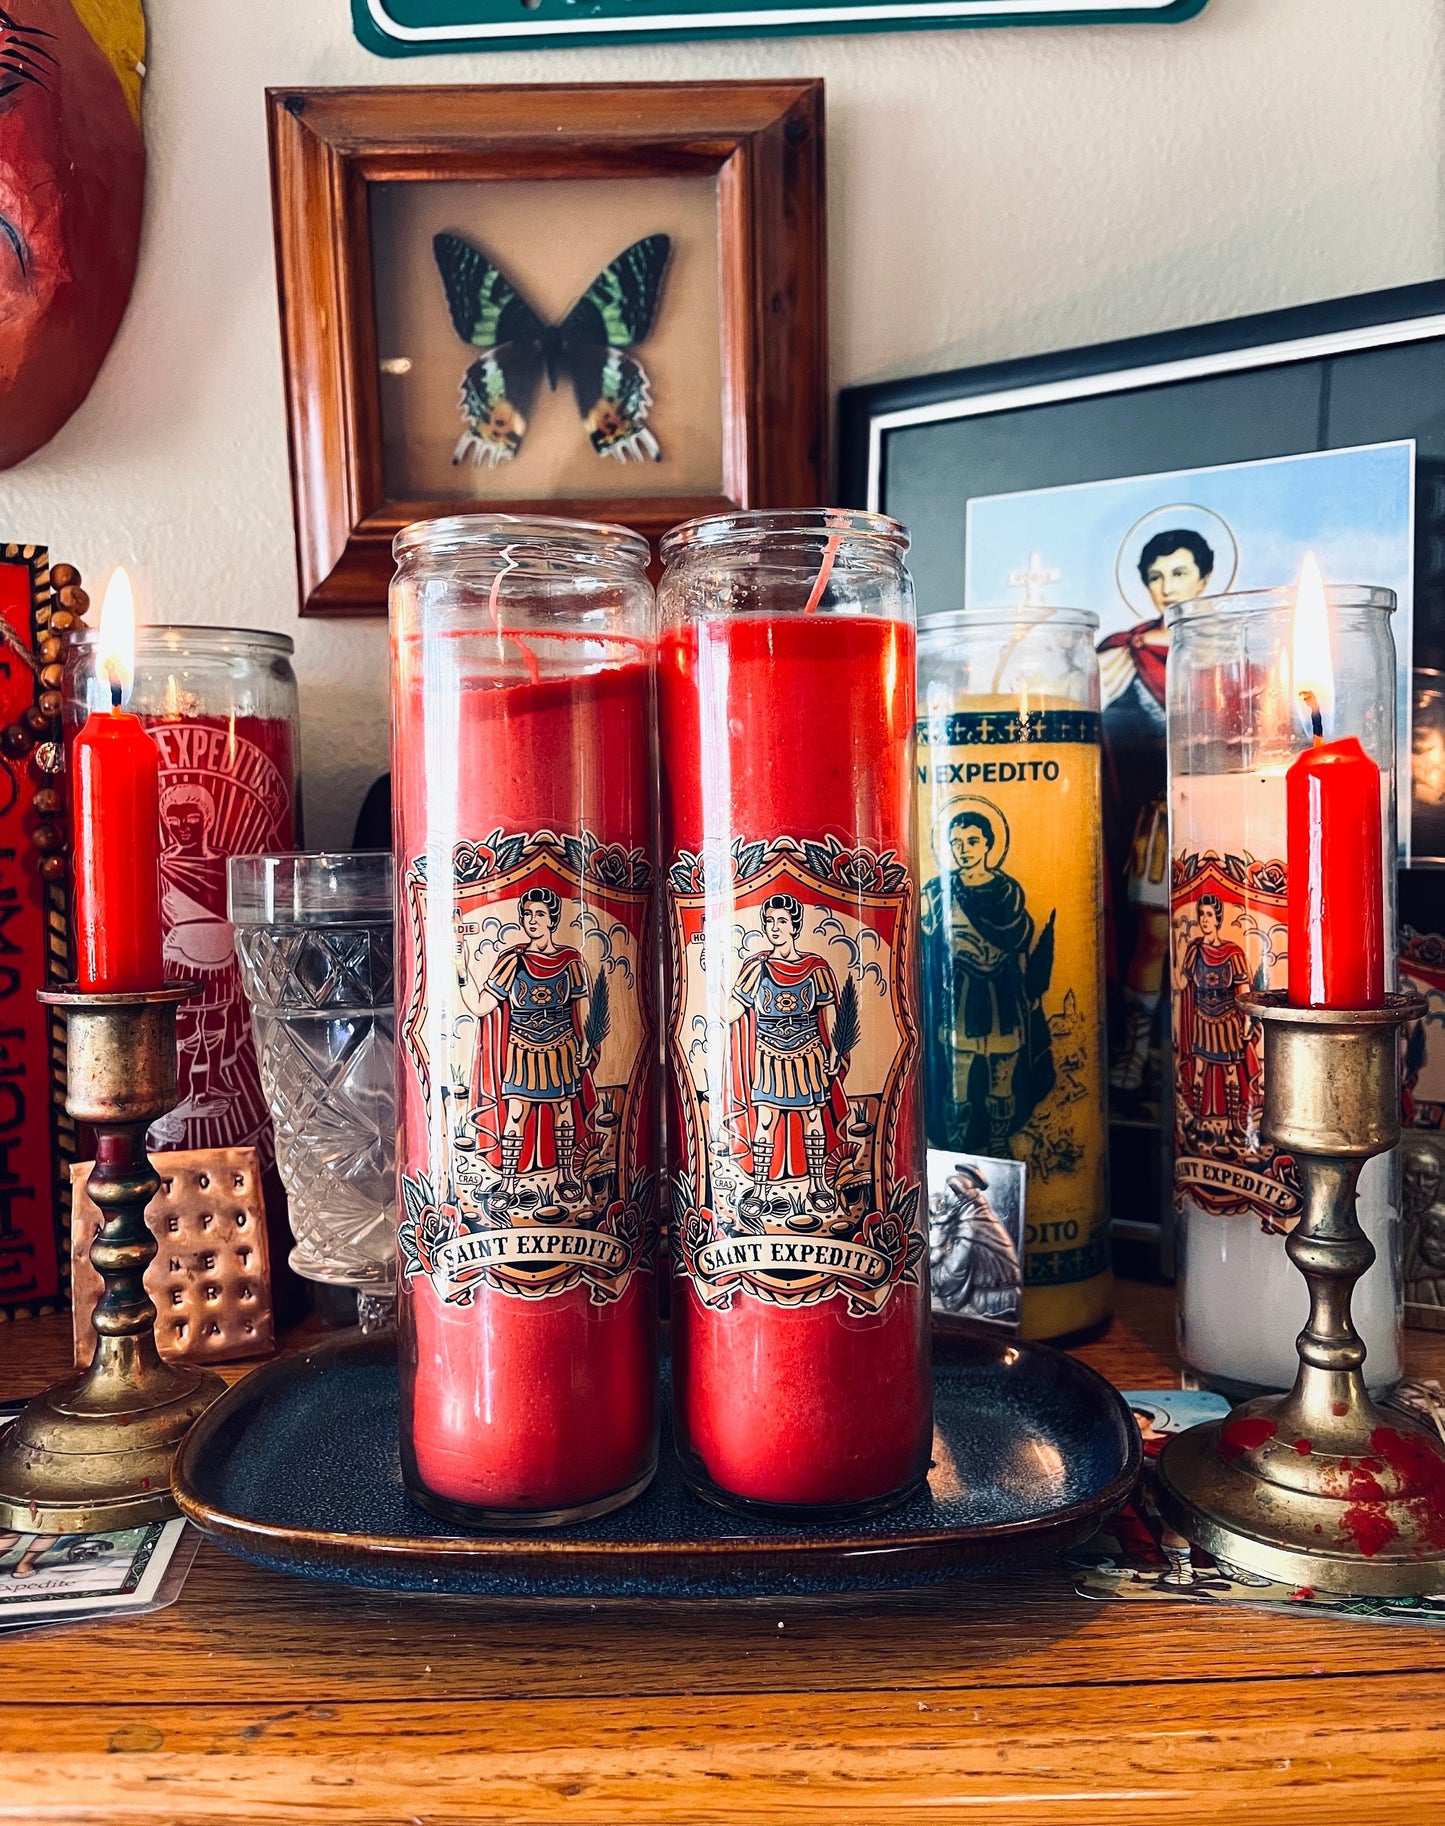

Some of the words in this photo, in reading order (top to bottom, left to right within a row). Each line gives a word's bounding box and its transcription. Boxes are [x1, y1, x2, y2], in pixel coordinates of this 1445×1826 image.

[156, 729, 276, 797] EXPEDITUS
[936, 760, 1059, 784] EXPEDITO
[457, 924, 475, 934] DIE
[162, 1172, 244, 1194] TOR
[458, 1174, 479, 1184] CRAS
[715, 1179, 733, 1189] CRAS
[1202, 1164, 1291, 1206] EXPEDITE
[1024, 1219, 1079, 1244] DITO
[169, 1251, 250, 1271] NET
[443, 1236, 508, 1267] SAINT
[516, 1235, 623, 1264] EXPEDITE
[704, 1243, 762, 1271] SAINT
[771, 1243, 881, 1276] EXPEDITE
[171, 1287, 253, 1305] ERA
[175, 1321, 254, 1339] TAS
